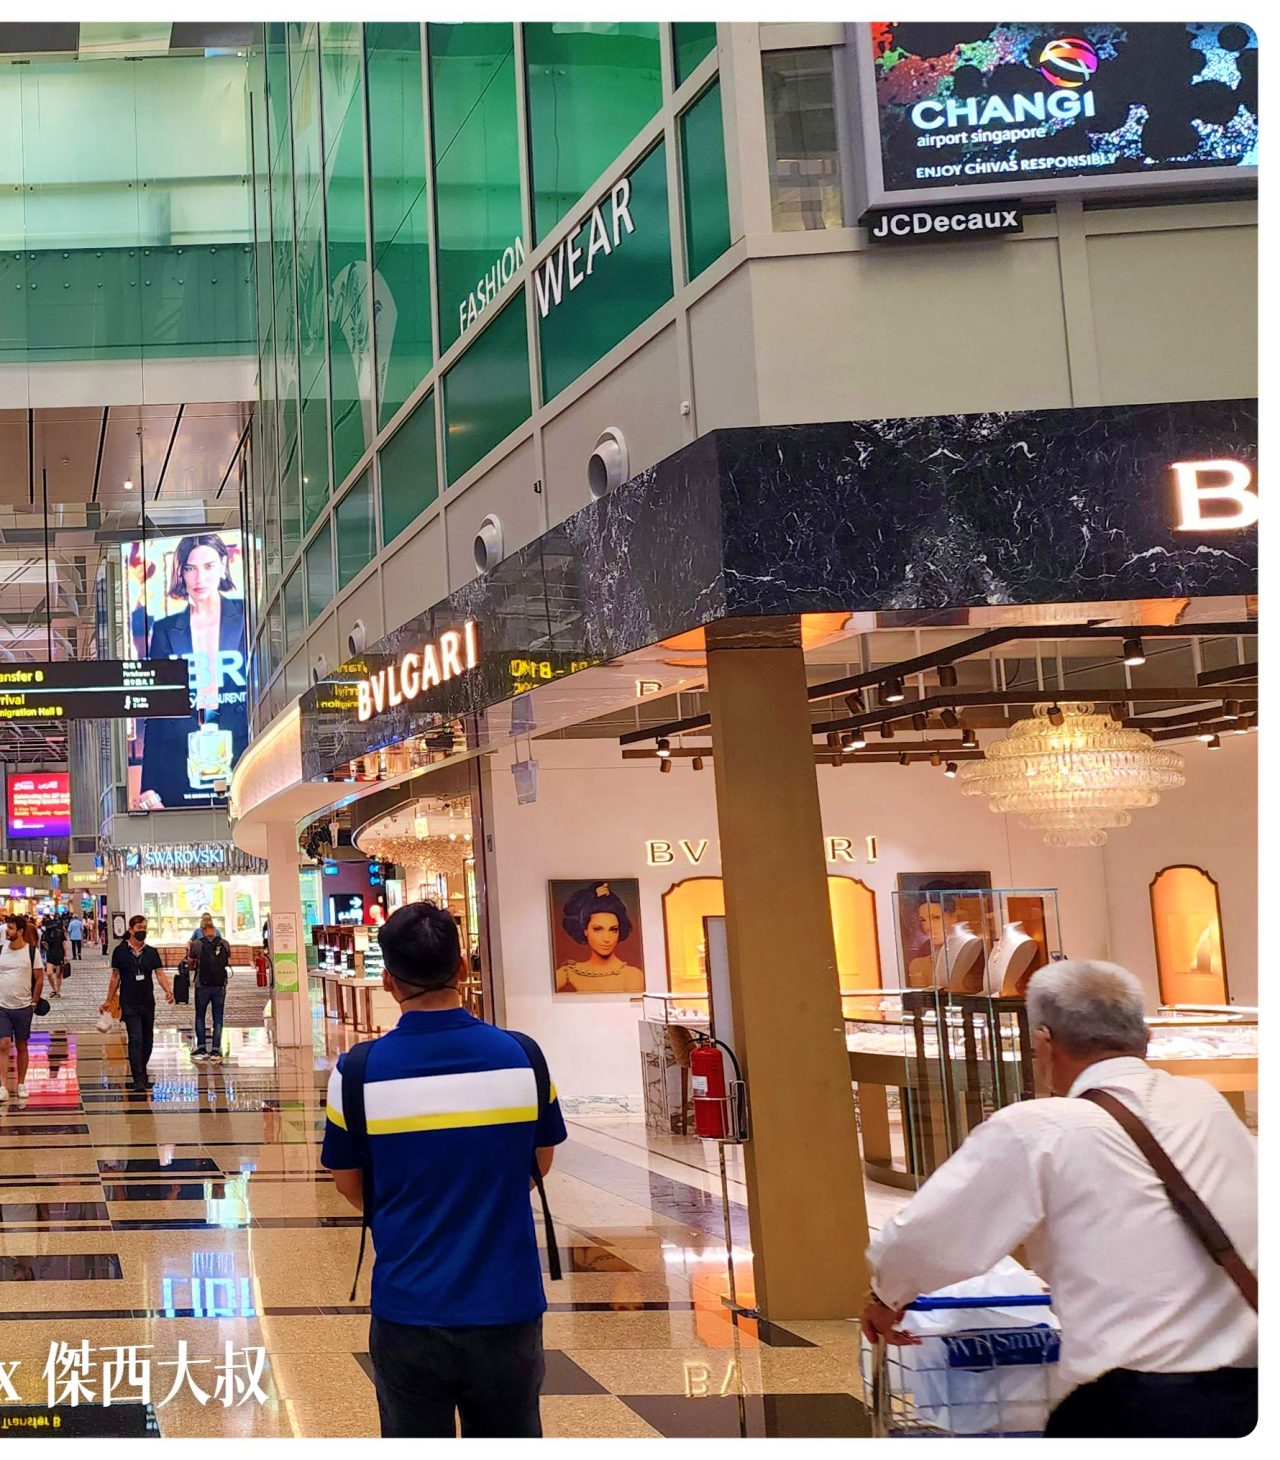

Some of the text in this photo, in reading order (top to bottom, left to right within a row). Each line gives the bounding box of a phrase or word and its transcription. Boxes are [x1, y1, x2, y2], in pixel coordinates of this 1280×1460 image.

[911, 90, 1096, 130] CHANGI
[916, 126, 1047, 148] airport singapore
[916, 153, 1118, 179] ENJOY CHIVAS RESPONSIBLY
[873, 210, 1019, 237] JCDecaux
[533, 177, 635, 318] WEAR
[459, 235, 526, 336] FASHION
[34, 670, 44, 682] B
[356, 620, 479, 722] BVLGARI
[38, 707, 56, 716] Hall
[144, 849, 225, 866] SWAROVSKI
